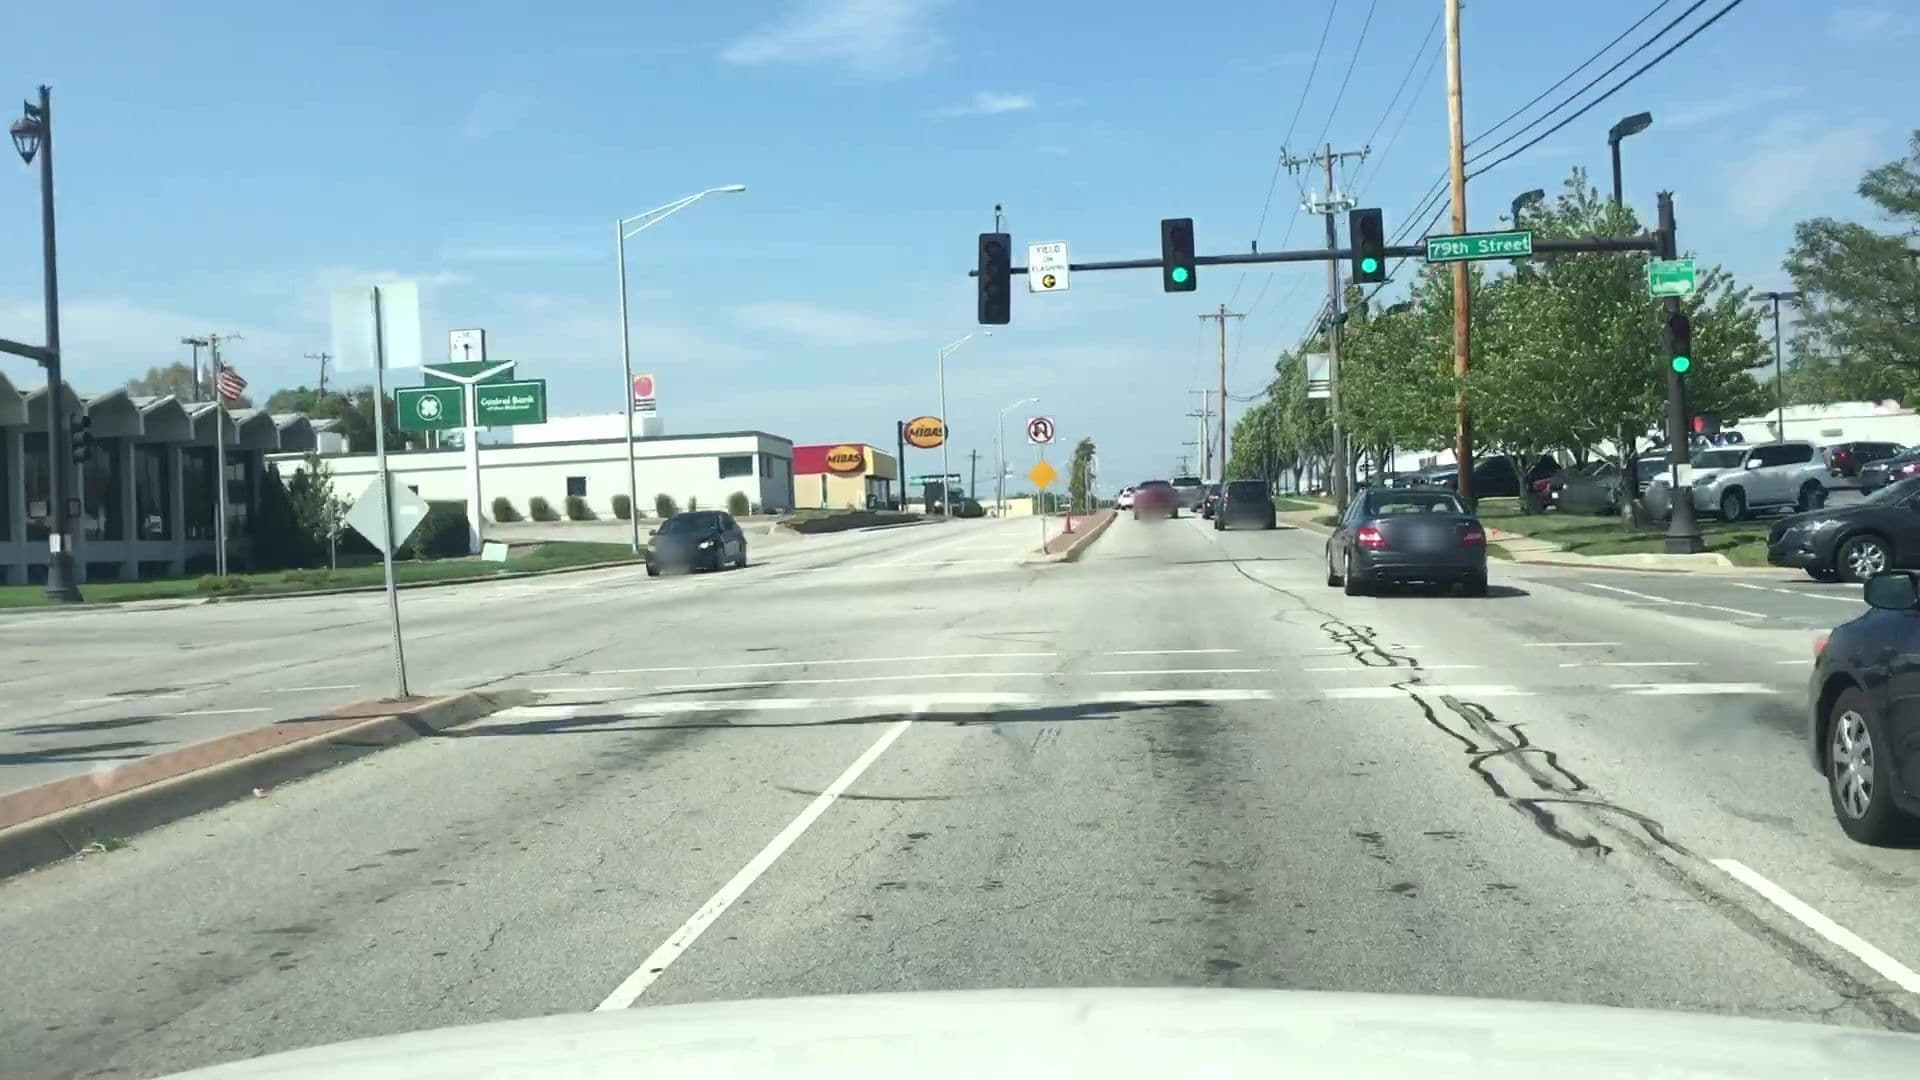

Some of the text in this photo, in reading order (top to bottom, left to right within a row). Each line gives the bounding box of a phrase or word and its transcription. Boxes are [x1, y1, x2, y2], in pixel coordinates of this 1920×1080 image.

[1035, 245, 1061, 254] YIELD
[1430, 236, 1529, 257] 79th Street
[480, 394, 535, 406] Central Bank
[827, 453, 861, 464] MIDAS
